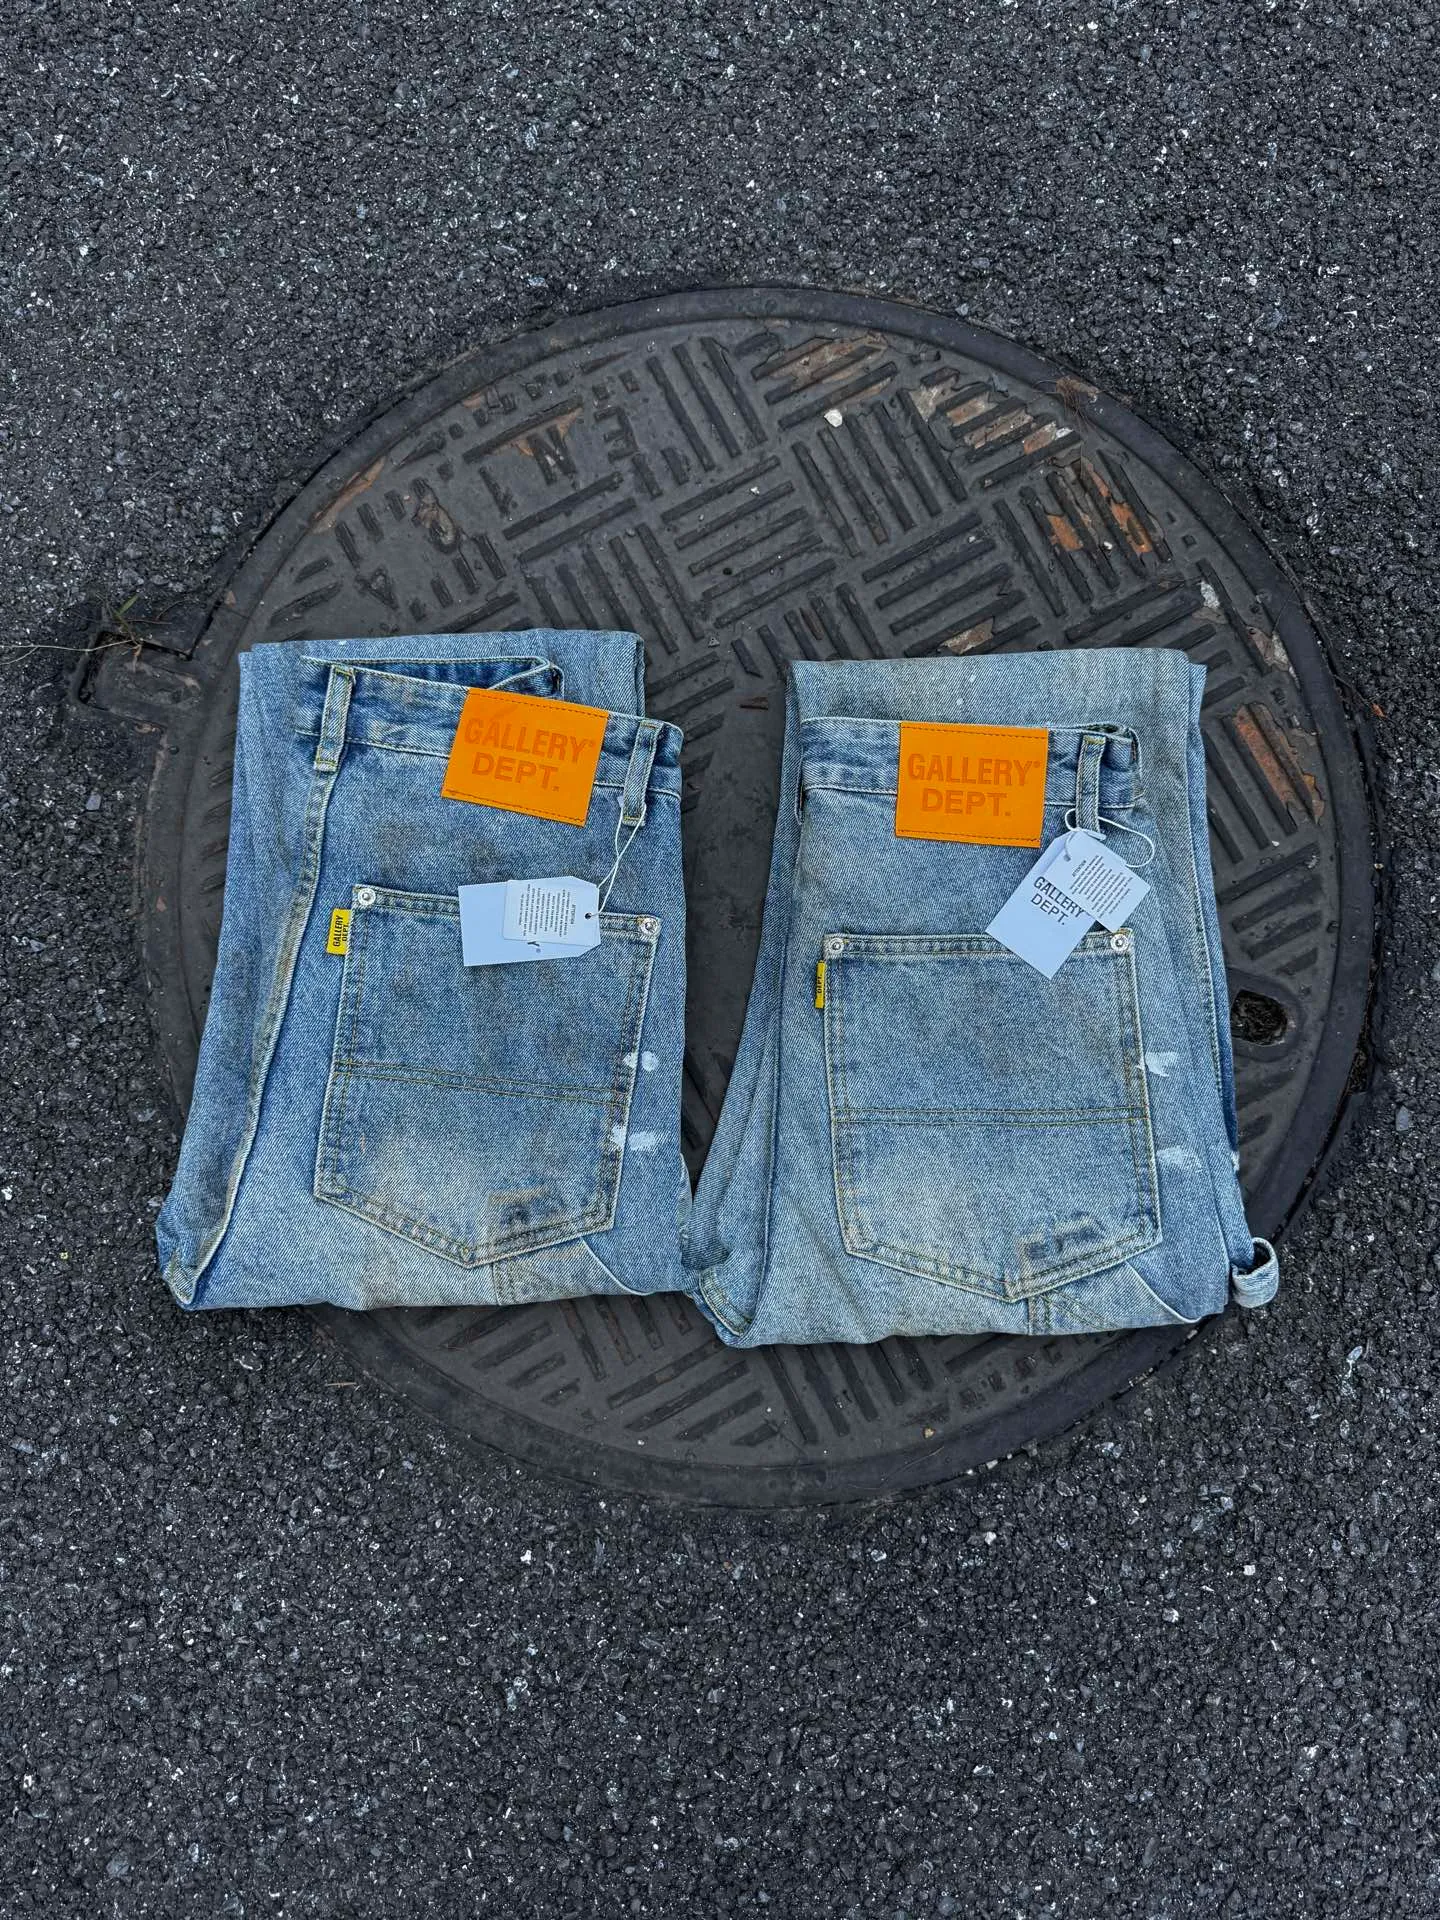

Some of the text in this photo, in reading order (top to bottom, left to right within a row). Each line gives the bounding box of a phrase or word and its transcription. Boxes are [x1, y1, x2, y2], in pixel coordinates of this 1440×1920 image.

[471, 752, 560, 792] DEPT.
[921, 788, 1012, 817] DEPT.
[1030, 893, 1069, 926] DEPT.
[1033, 876, 1085, 918] GALLERY
[332, 915, 344, 947] GALLERY
